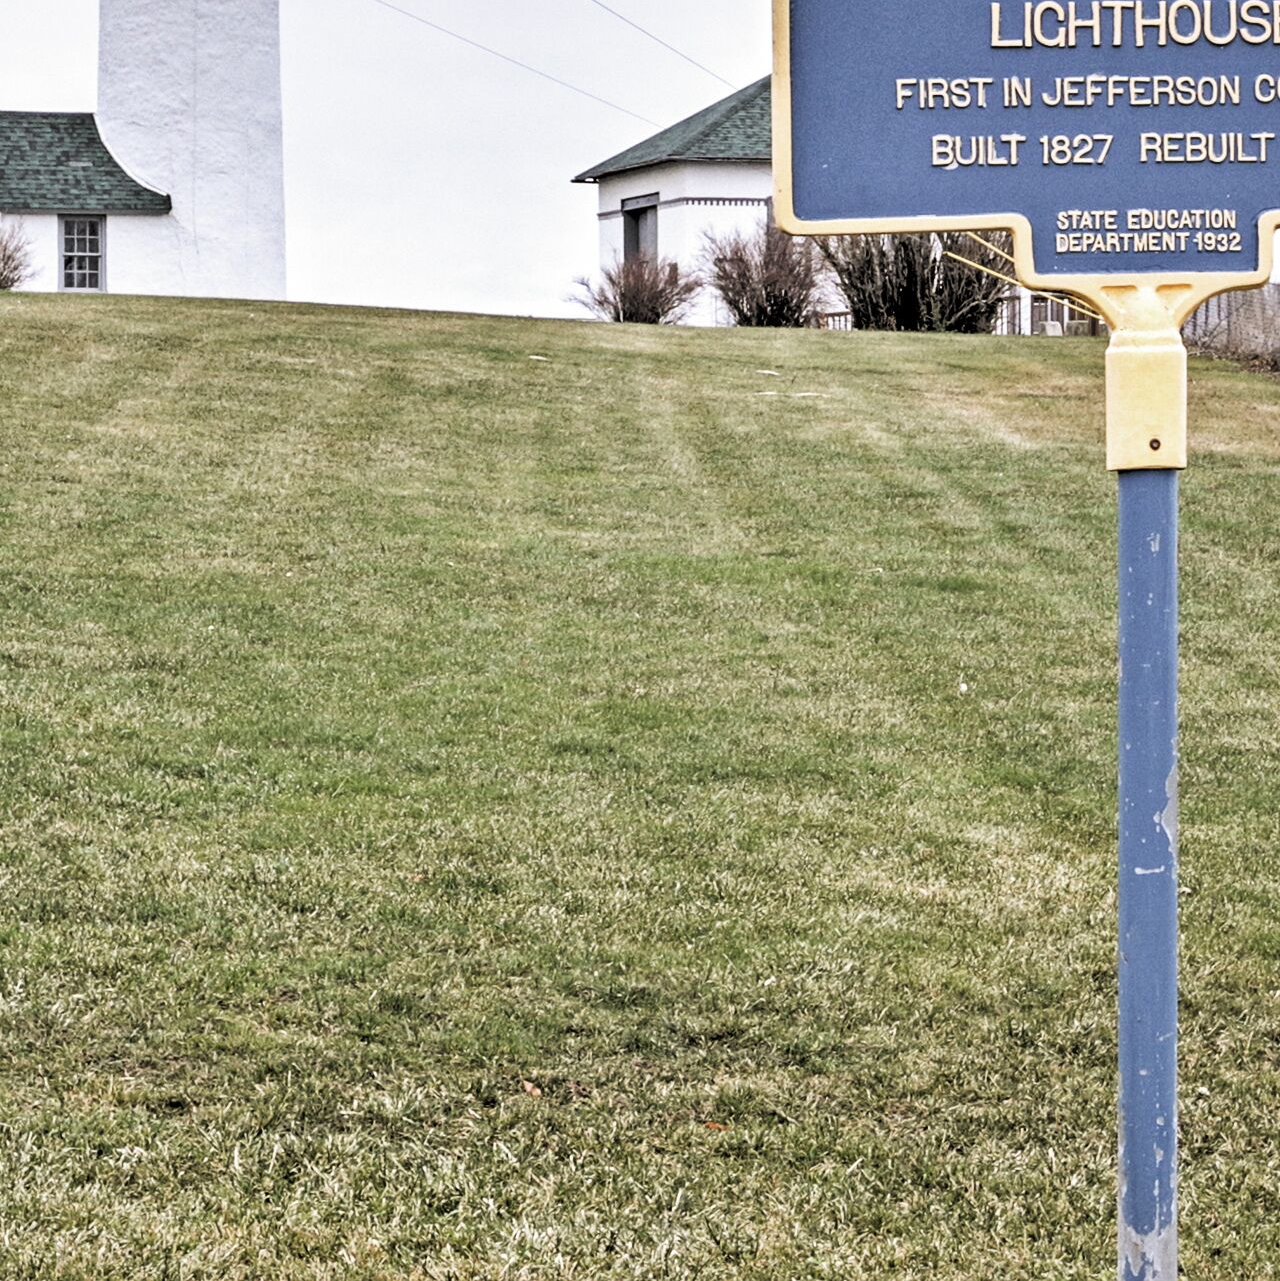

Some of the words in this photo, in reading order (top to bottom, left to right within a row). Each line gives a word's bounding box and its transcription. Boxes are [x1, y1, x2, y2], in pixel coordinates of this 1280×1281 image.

[895, 77, 994, 109] FIRST
[1003, 76, 1032, 107] IN
[1041, 73, 1240, 107] JEFFERSON
[931, 133, 1027, 166] BUILT
[1039, 134, 1114, 165] 1827
[1139, 131, 1276, 163] REBUILT
[1056, 209, 1118, 230] STATE
[1127, 208, 1236, 230] EDUCATION
[1055, 232, 1191, 253] DEPARTMENT
